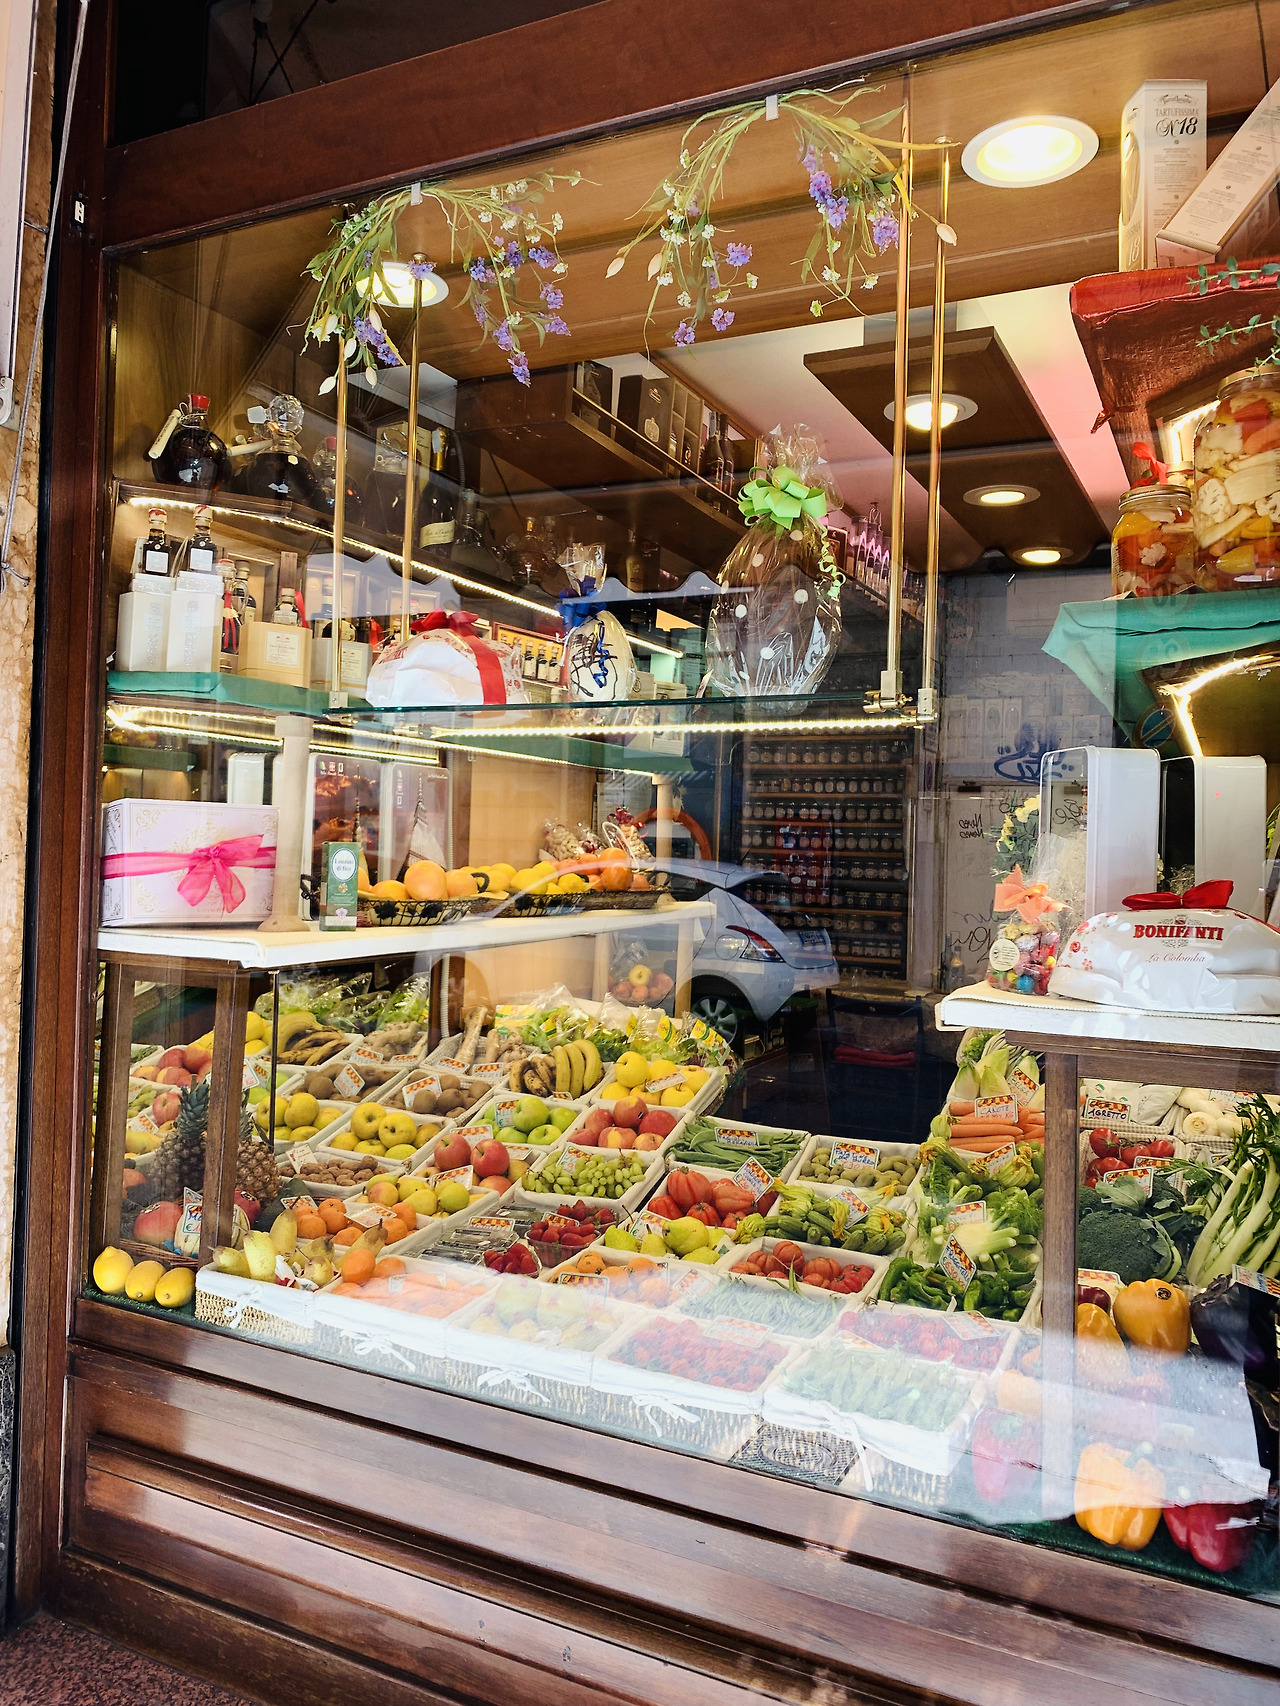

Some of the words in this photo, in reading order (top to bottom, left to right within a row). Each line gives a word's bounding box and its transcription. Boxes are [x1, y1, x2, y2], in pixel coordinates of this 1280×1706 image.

[1155, 107, 1199, 117] TARTUFISSIMA
[1133, 925, 1224, 941] BONIFANTI
[1163, 952, 1206, 962] Colomba
[1088, 1108, 1127, 1120] AGRETTO
